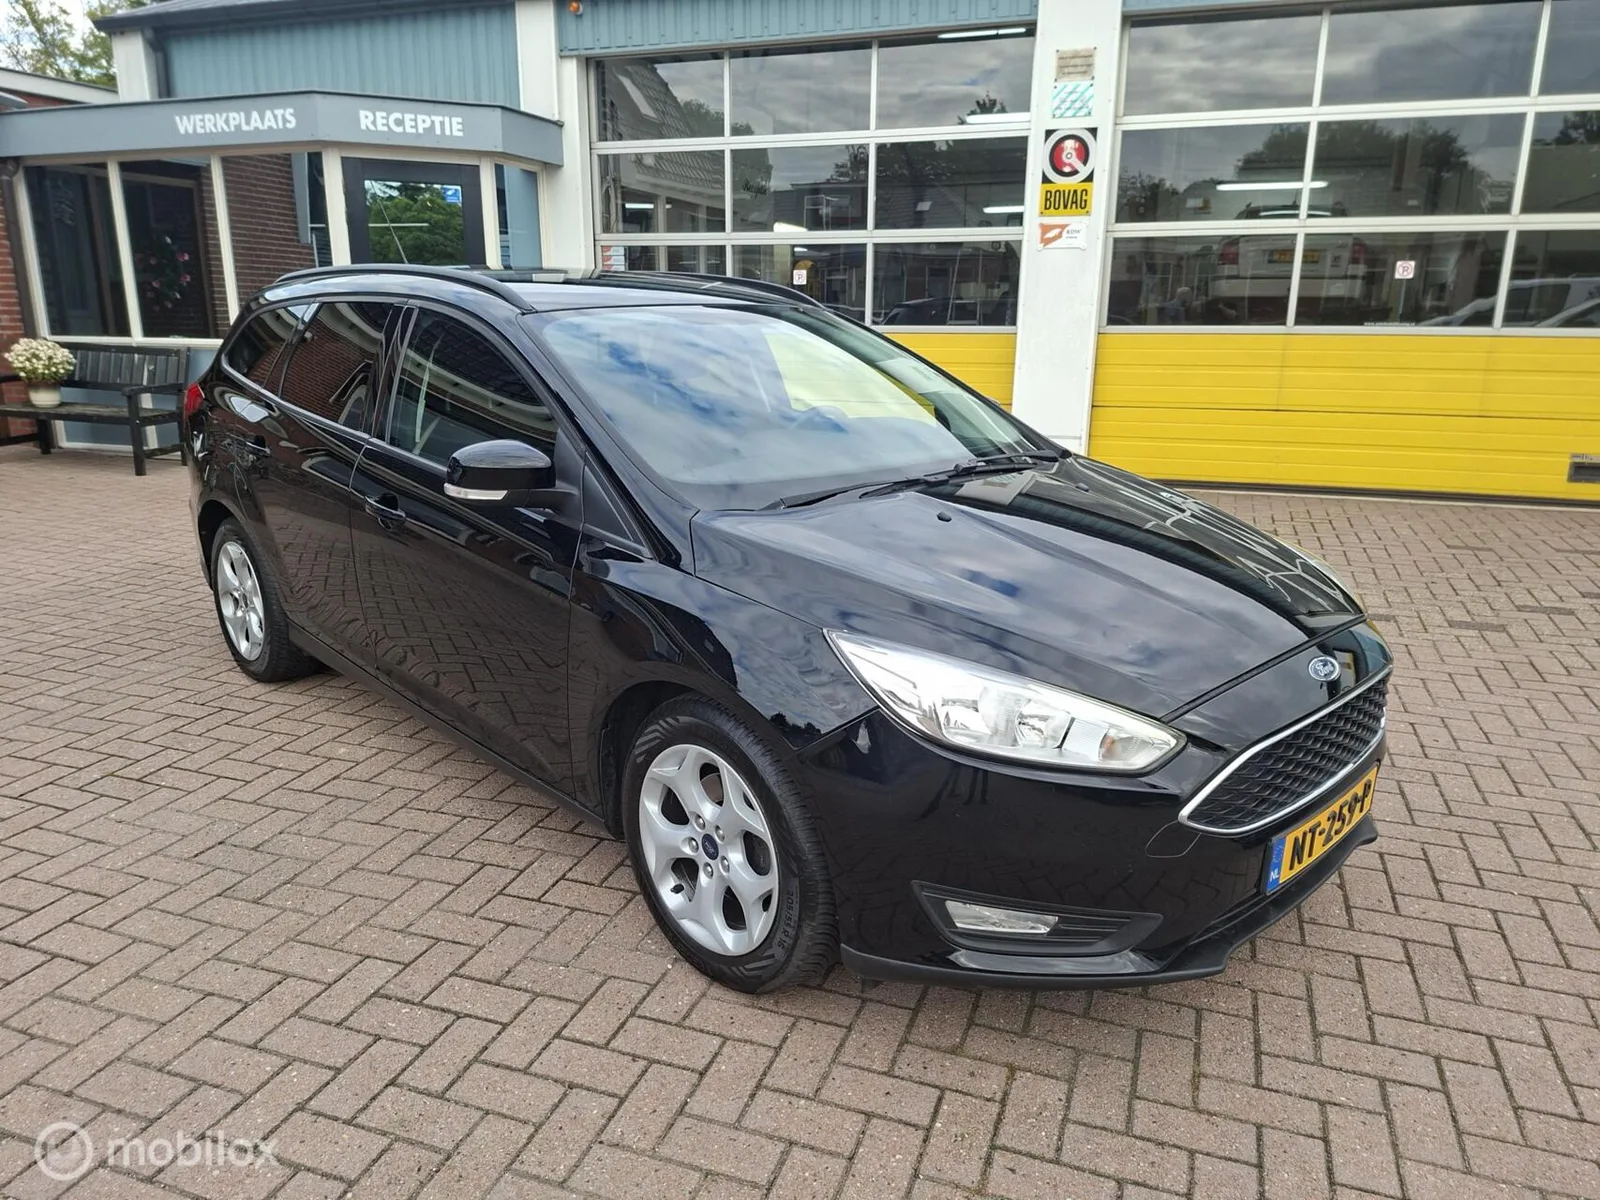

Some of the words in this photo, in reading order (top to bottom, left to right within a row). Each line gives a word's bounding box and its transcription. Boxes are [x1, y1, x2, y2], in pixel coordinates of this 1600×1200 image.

[174, 108, 297, 135] WERKPLAATS
[359, 109, 464, 137] RECEPTIE
[1044, 188, 1088, 211] BOVAG
[1315, 661, 1334, 677] Ford
[1289, 778, 1373, 871] NT-259-P
[1269, 870, 1279, 882] NL
